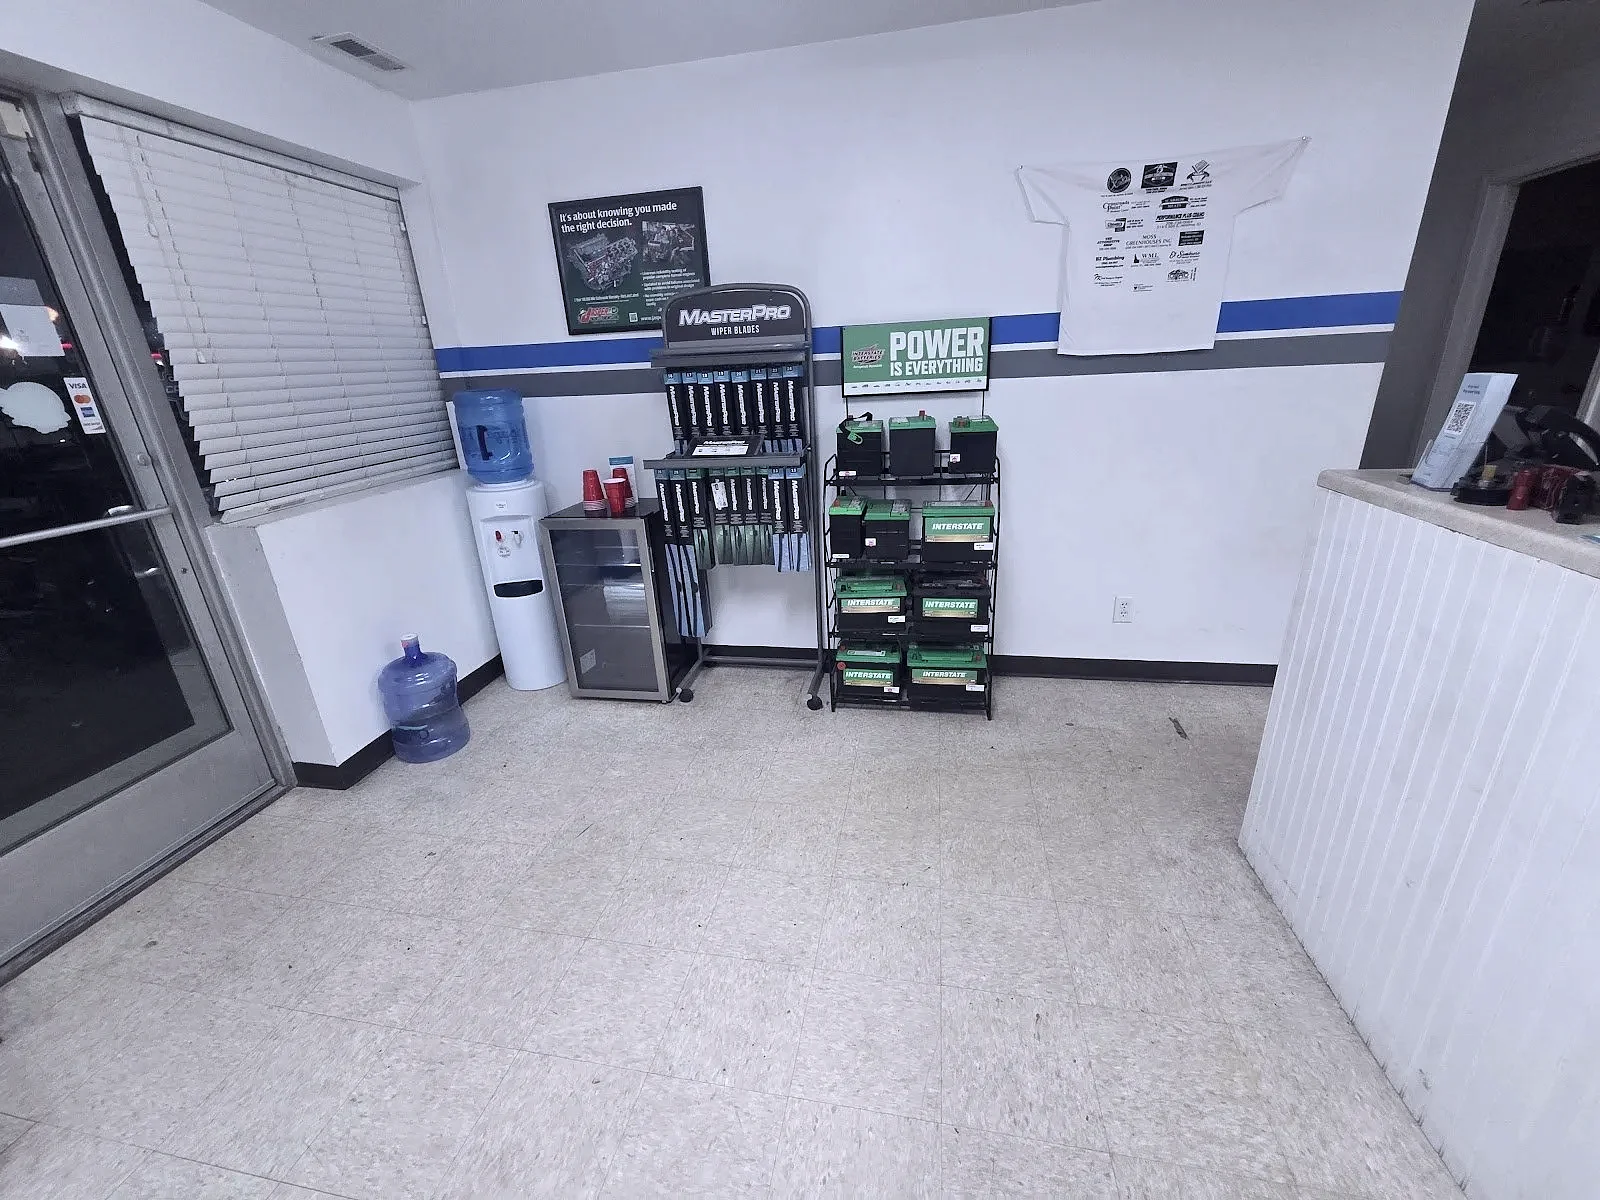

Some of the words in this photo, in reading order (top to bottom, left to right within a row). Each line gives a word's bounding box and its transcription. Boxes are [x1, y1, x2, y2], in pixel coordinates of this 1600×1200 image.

[559, 212, 572, 223] It's
[572, 208, 598, 221] about
[597, 205, 634, 218] knowing
[634, 204, 652, 217] you
[652, 202, 678, 212] made
[560, 222, 577, 234] the
[575, 219, 597, 233] right
[596, 217, 633, 231] decision.
[711, 327, 732, 336] WIPER
[735, 325, 760, 335] BLADES
[890, 327, 985, 361] POWER
[890, 361, 903, 377] IS
[905, 358, 984, 376] EVERYTHING
[932, 523, 984, 531] INTERSTATE
[924, 600, 976, 609] INTERSTATE
[846, 672, 892, 681] INTERSTATE
